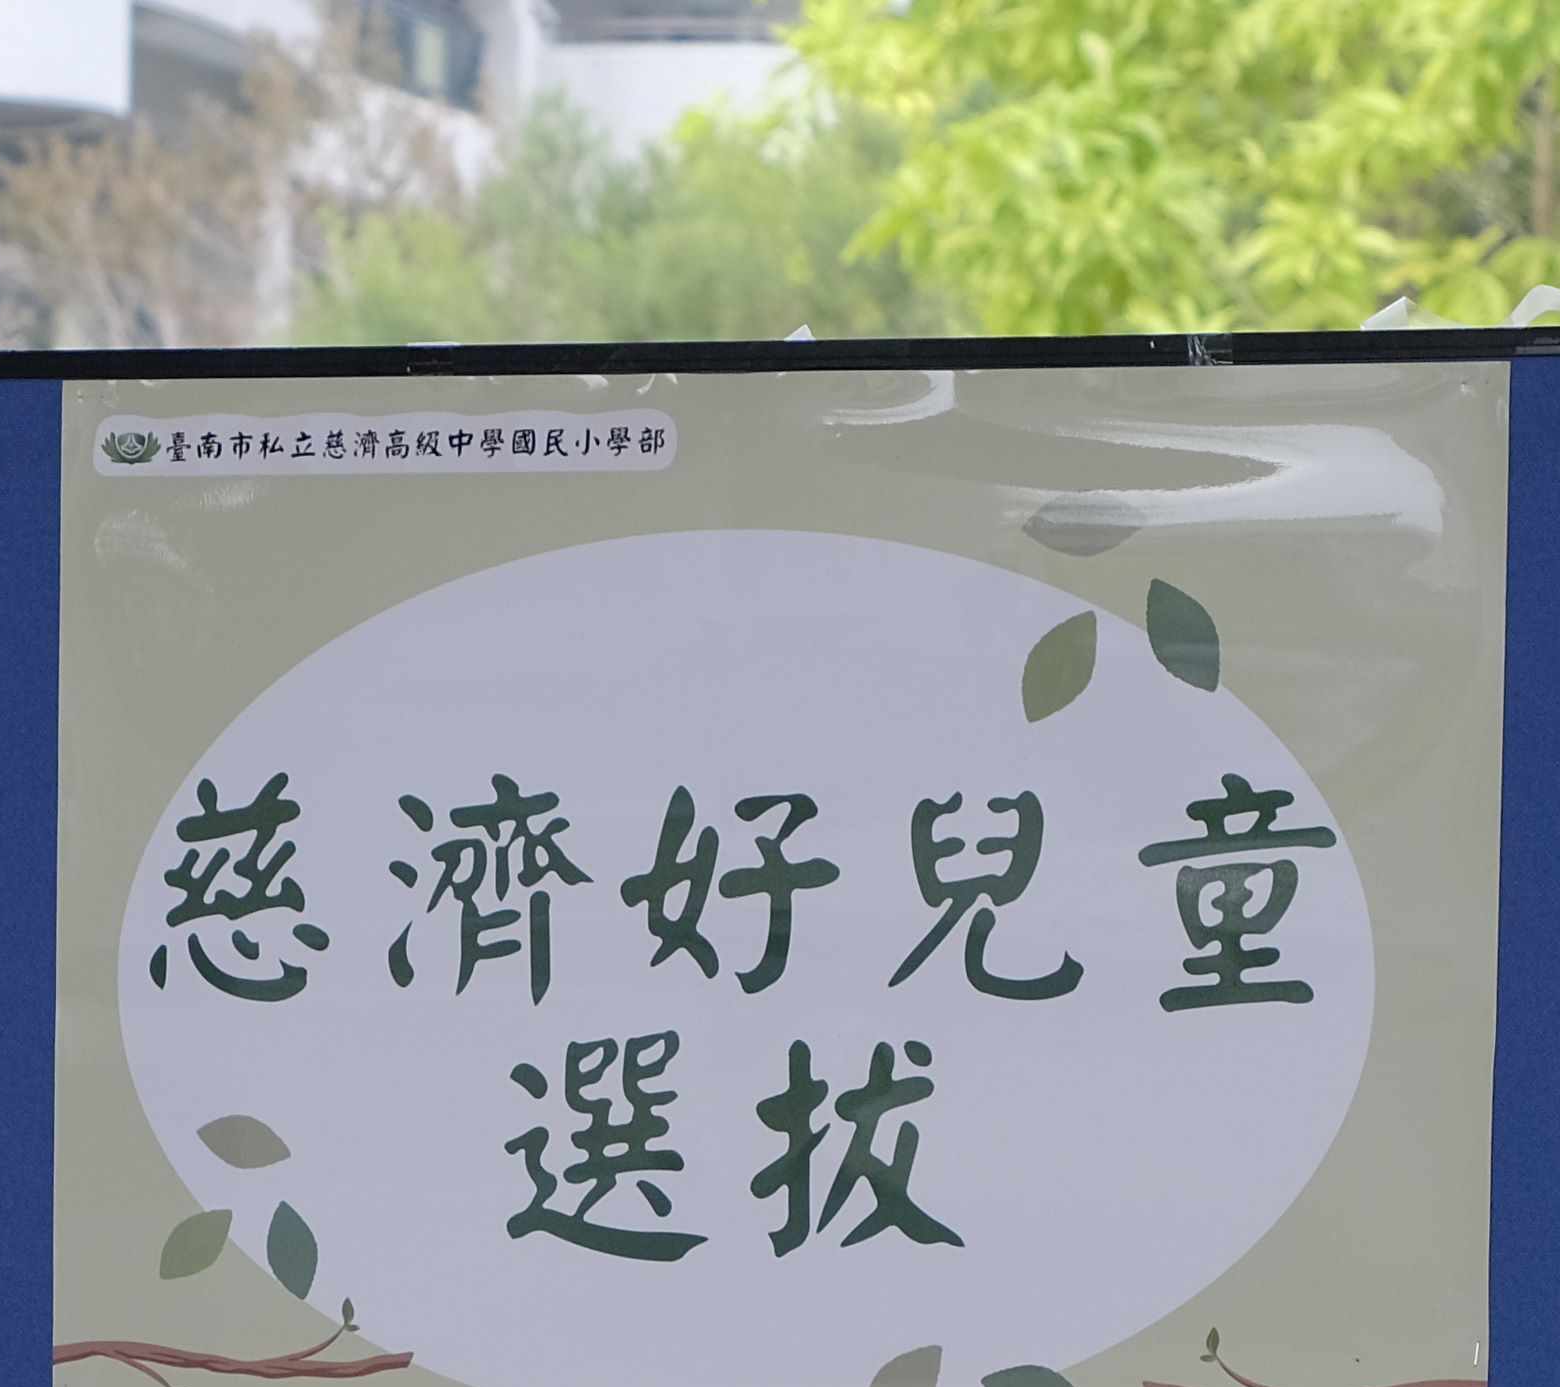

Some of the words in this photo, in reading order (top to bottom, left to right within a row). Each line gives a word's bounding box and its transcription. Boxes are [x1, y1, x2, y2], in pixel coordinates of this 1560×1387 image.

[166, 426, 667, 463] 臺南市私立慈濟高級中學國民小學部
[149, 772, 1338, 1014] 慈濟好兒童
[504, 1030, 966, 1263] 選拔
